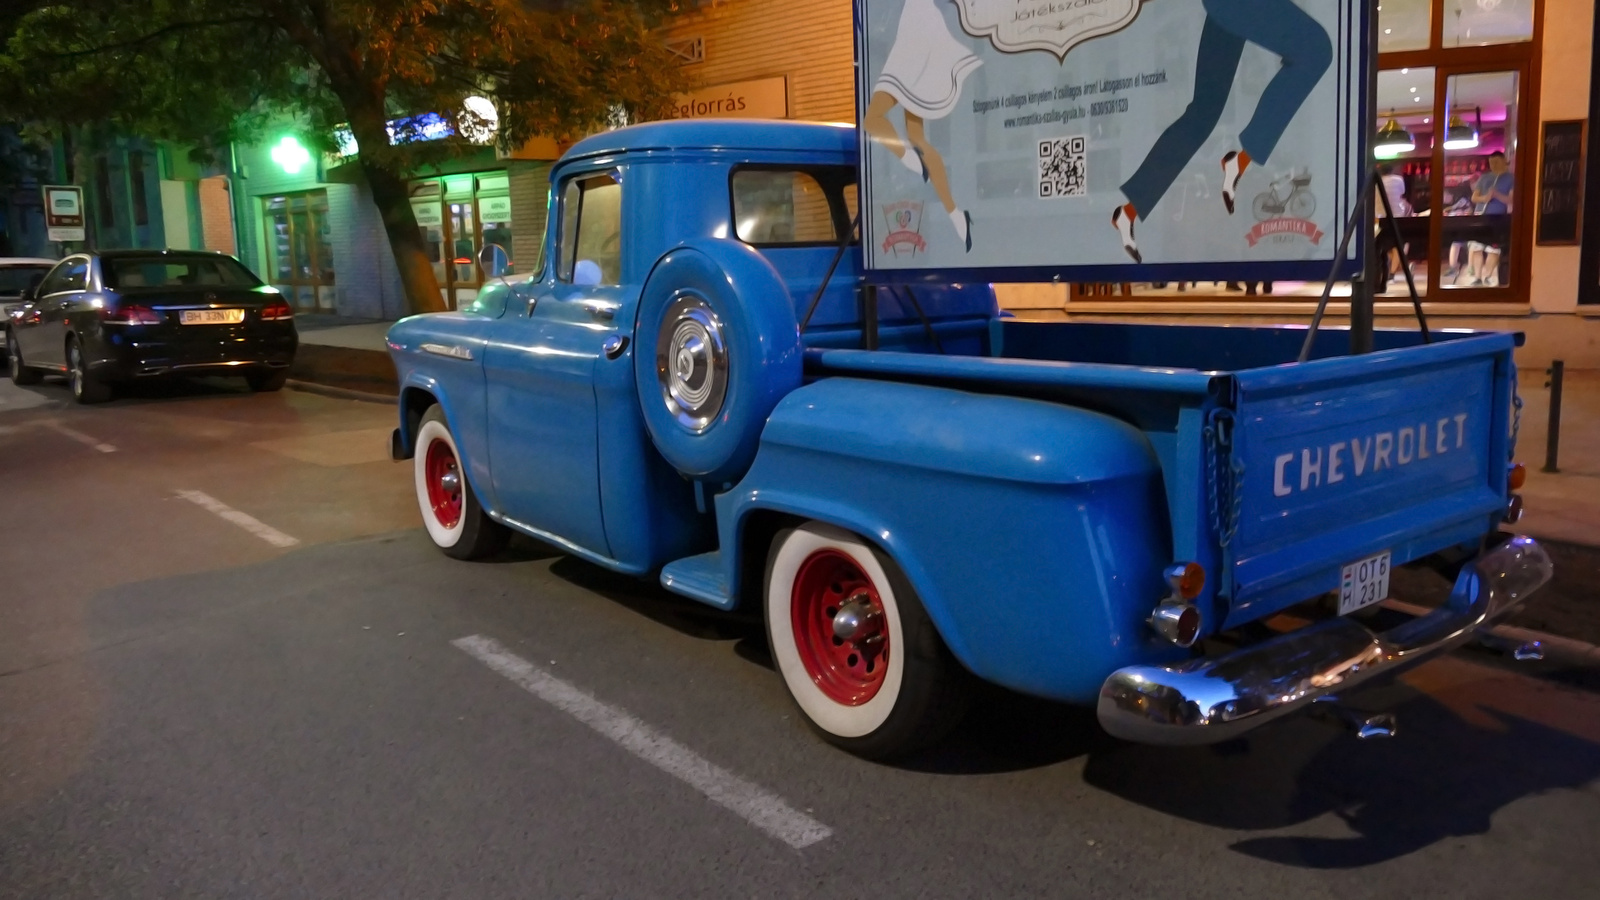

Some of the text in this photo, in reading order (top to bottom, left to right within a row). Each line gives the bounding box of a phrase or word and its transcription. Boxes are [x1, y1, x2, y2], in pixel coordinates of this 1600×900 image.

[1005, 94, 1027, 110] csillagos
[1058, 84, 1082, 102] csillagos
[1134, 73, 1141, 88] el
[1261, 219, 1307, 236] ROMANTIKA
[186, 311, 202, 322] BH
[1273, 412, 1468, 498] CHEVROLET
[1359, 554, 1389, 584] OT6
[1342, 590, 1352, 607] H
[1360, 580, 1382, 605] 231
